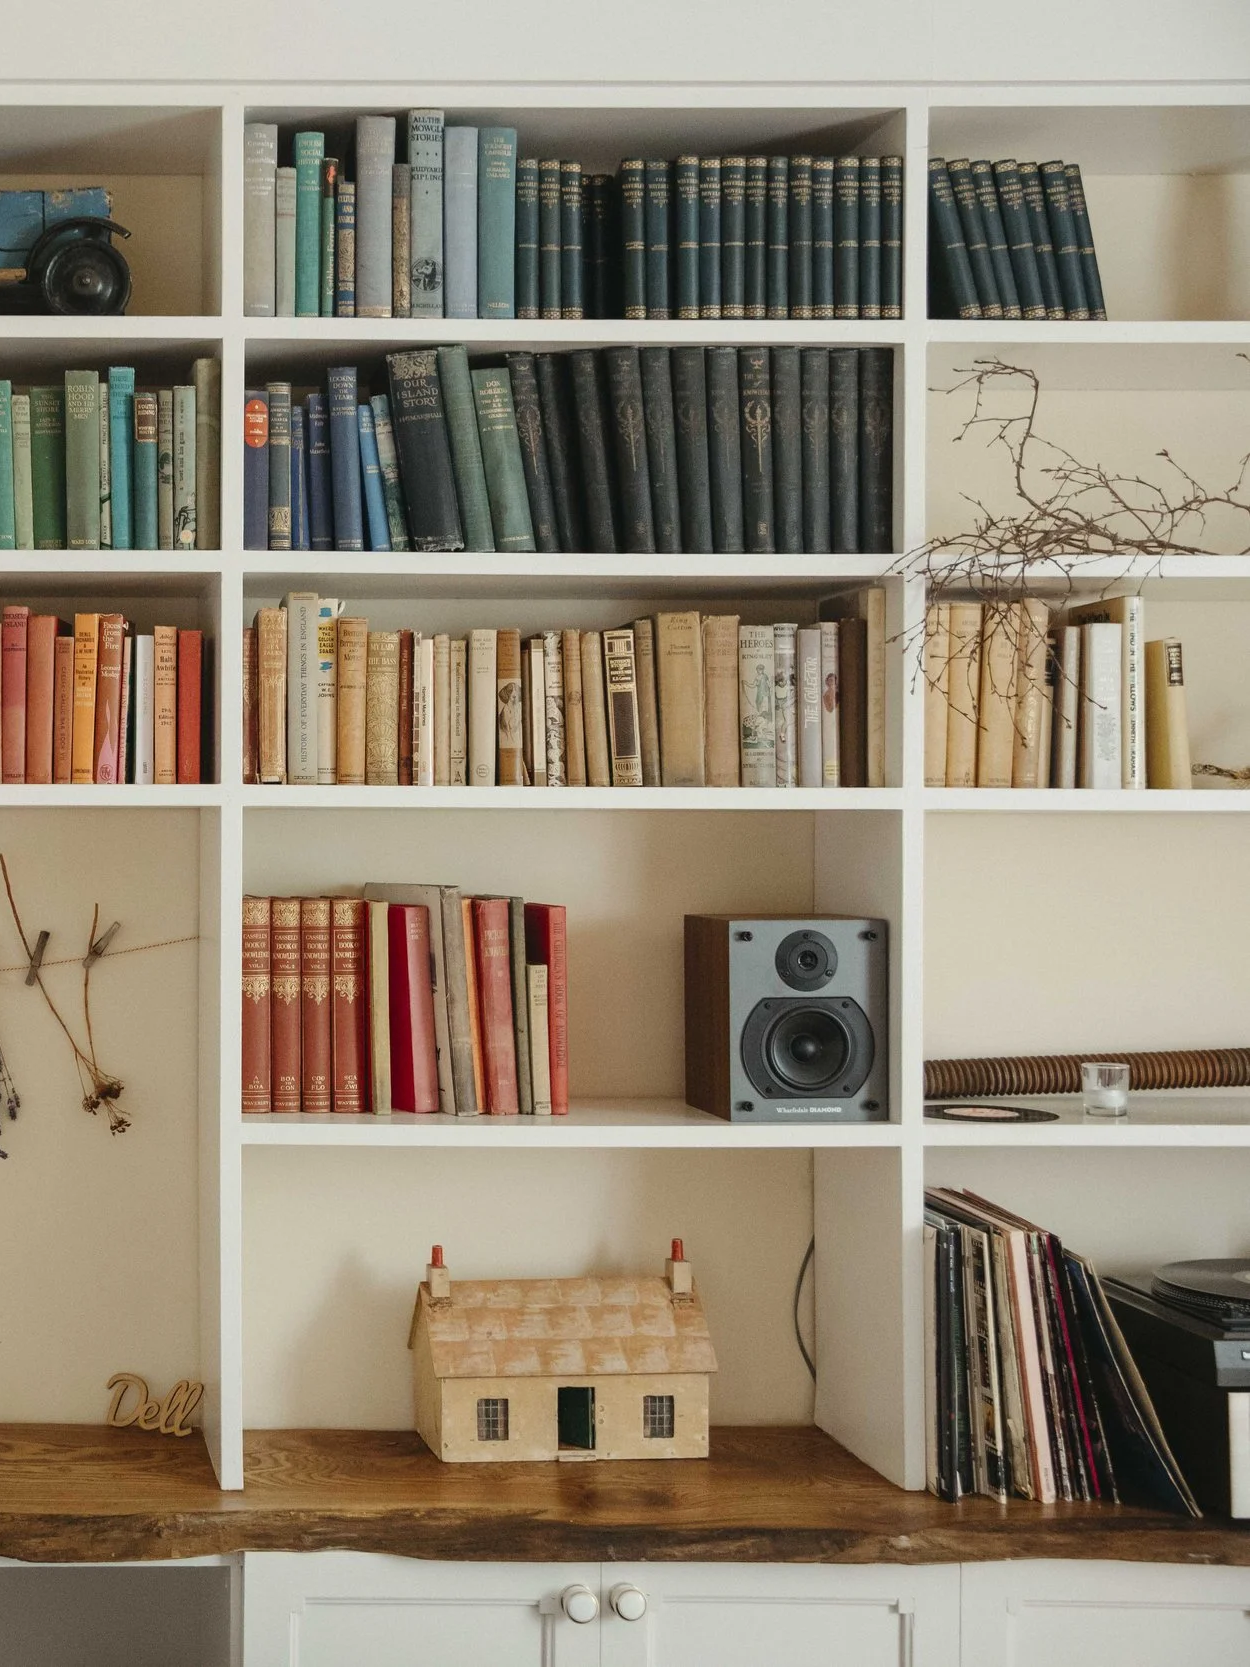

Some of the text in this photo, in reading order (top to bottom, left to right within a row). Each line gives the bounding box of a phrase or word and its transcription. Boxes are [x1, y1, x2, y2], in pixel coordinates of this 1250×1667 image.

[300, 643, 307, 651] IN
[740, 639, 774, 648] HEROES
[300, 719, 307, 730] OF
[107, 1372, 204, 1437] Dell
